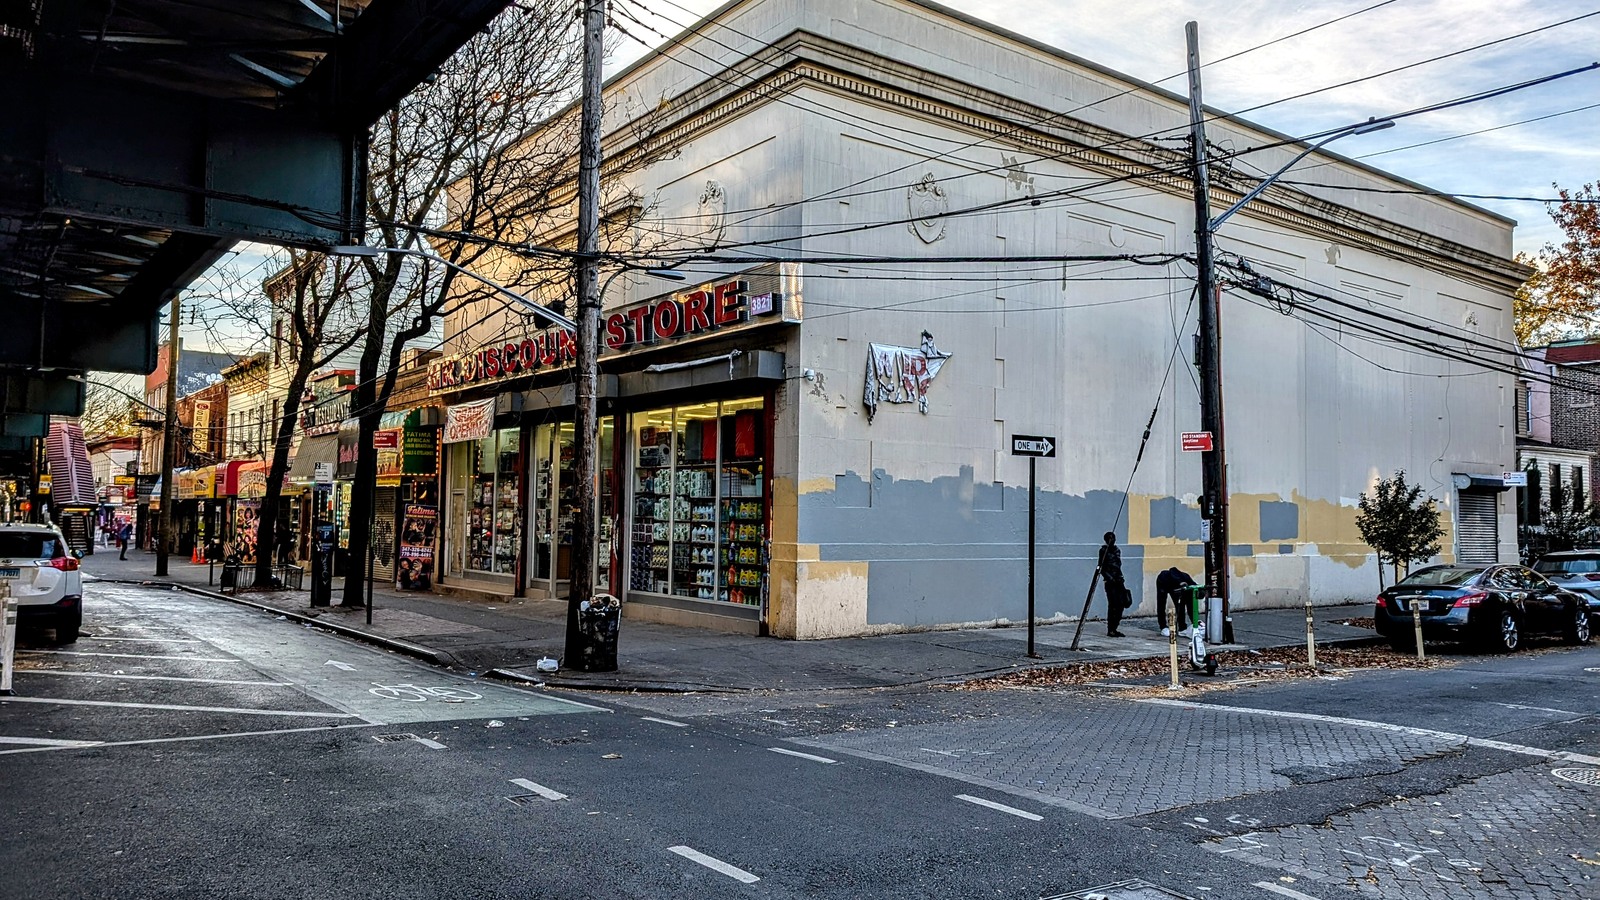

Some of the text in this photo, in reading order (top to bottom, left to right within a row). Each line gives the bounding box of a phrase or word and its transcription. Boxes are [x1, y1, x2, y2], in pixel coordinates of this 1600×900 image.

[752, 296, 772, 313] 3821
[464, 329, 578, 382] DISCOUN
[605, 279, 748, 350] STORE
[1018, 441, 1049, 451] ONE WAY
[407, 505, 435, 516] Fatima
